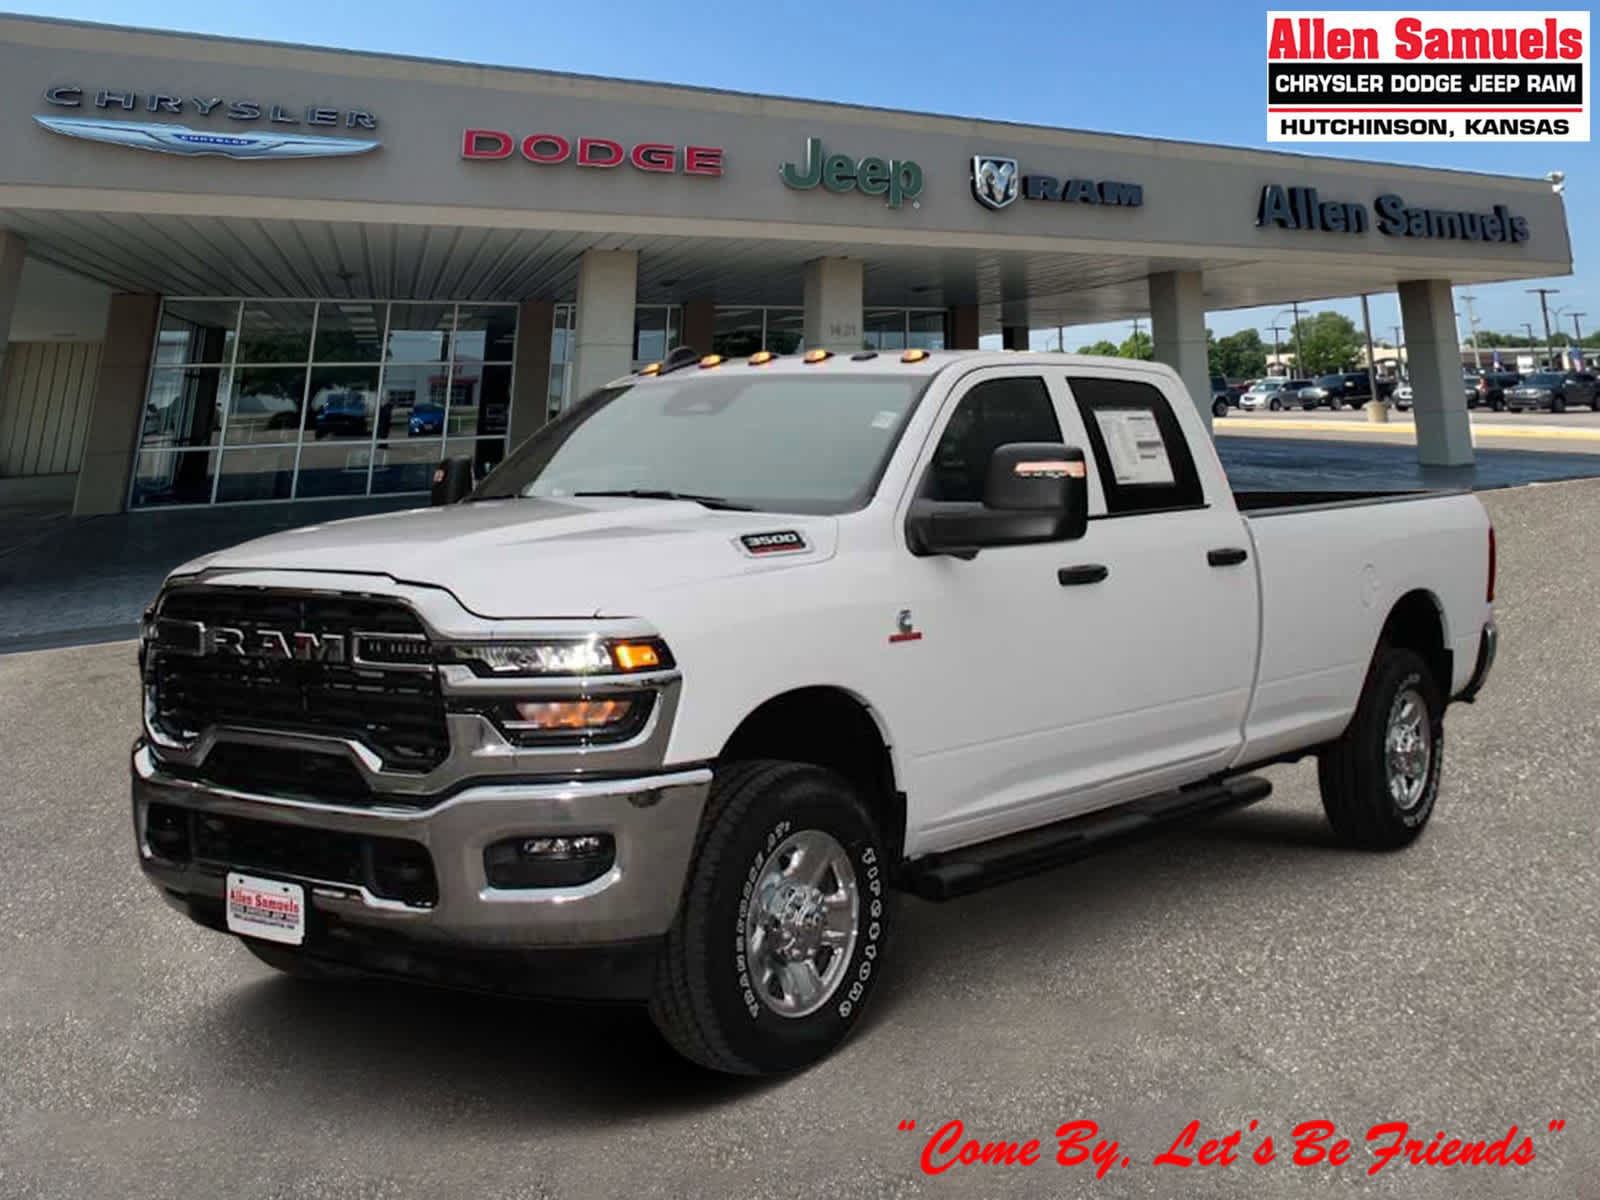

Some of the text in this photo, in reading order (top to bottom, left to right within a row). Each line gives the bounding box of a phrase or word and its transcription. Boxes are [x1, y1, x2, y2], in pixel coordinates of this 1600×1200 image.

[45, 87, 377, 128] CHRYSLER
[462, 129, 724, 176] DODGE
[780, 137, 923, 209] Jeep
[1023, 175, 1144, 207] RAM
[1256, 184, 1530, 243] Allen Samuels
[744, 534, 799, 547] 3500
[207, 624, 346, 664] RAM
[230, 889, 252, 905] Allen
[256, 893, 299, 913] Samuels
